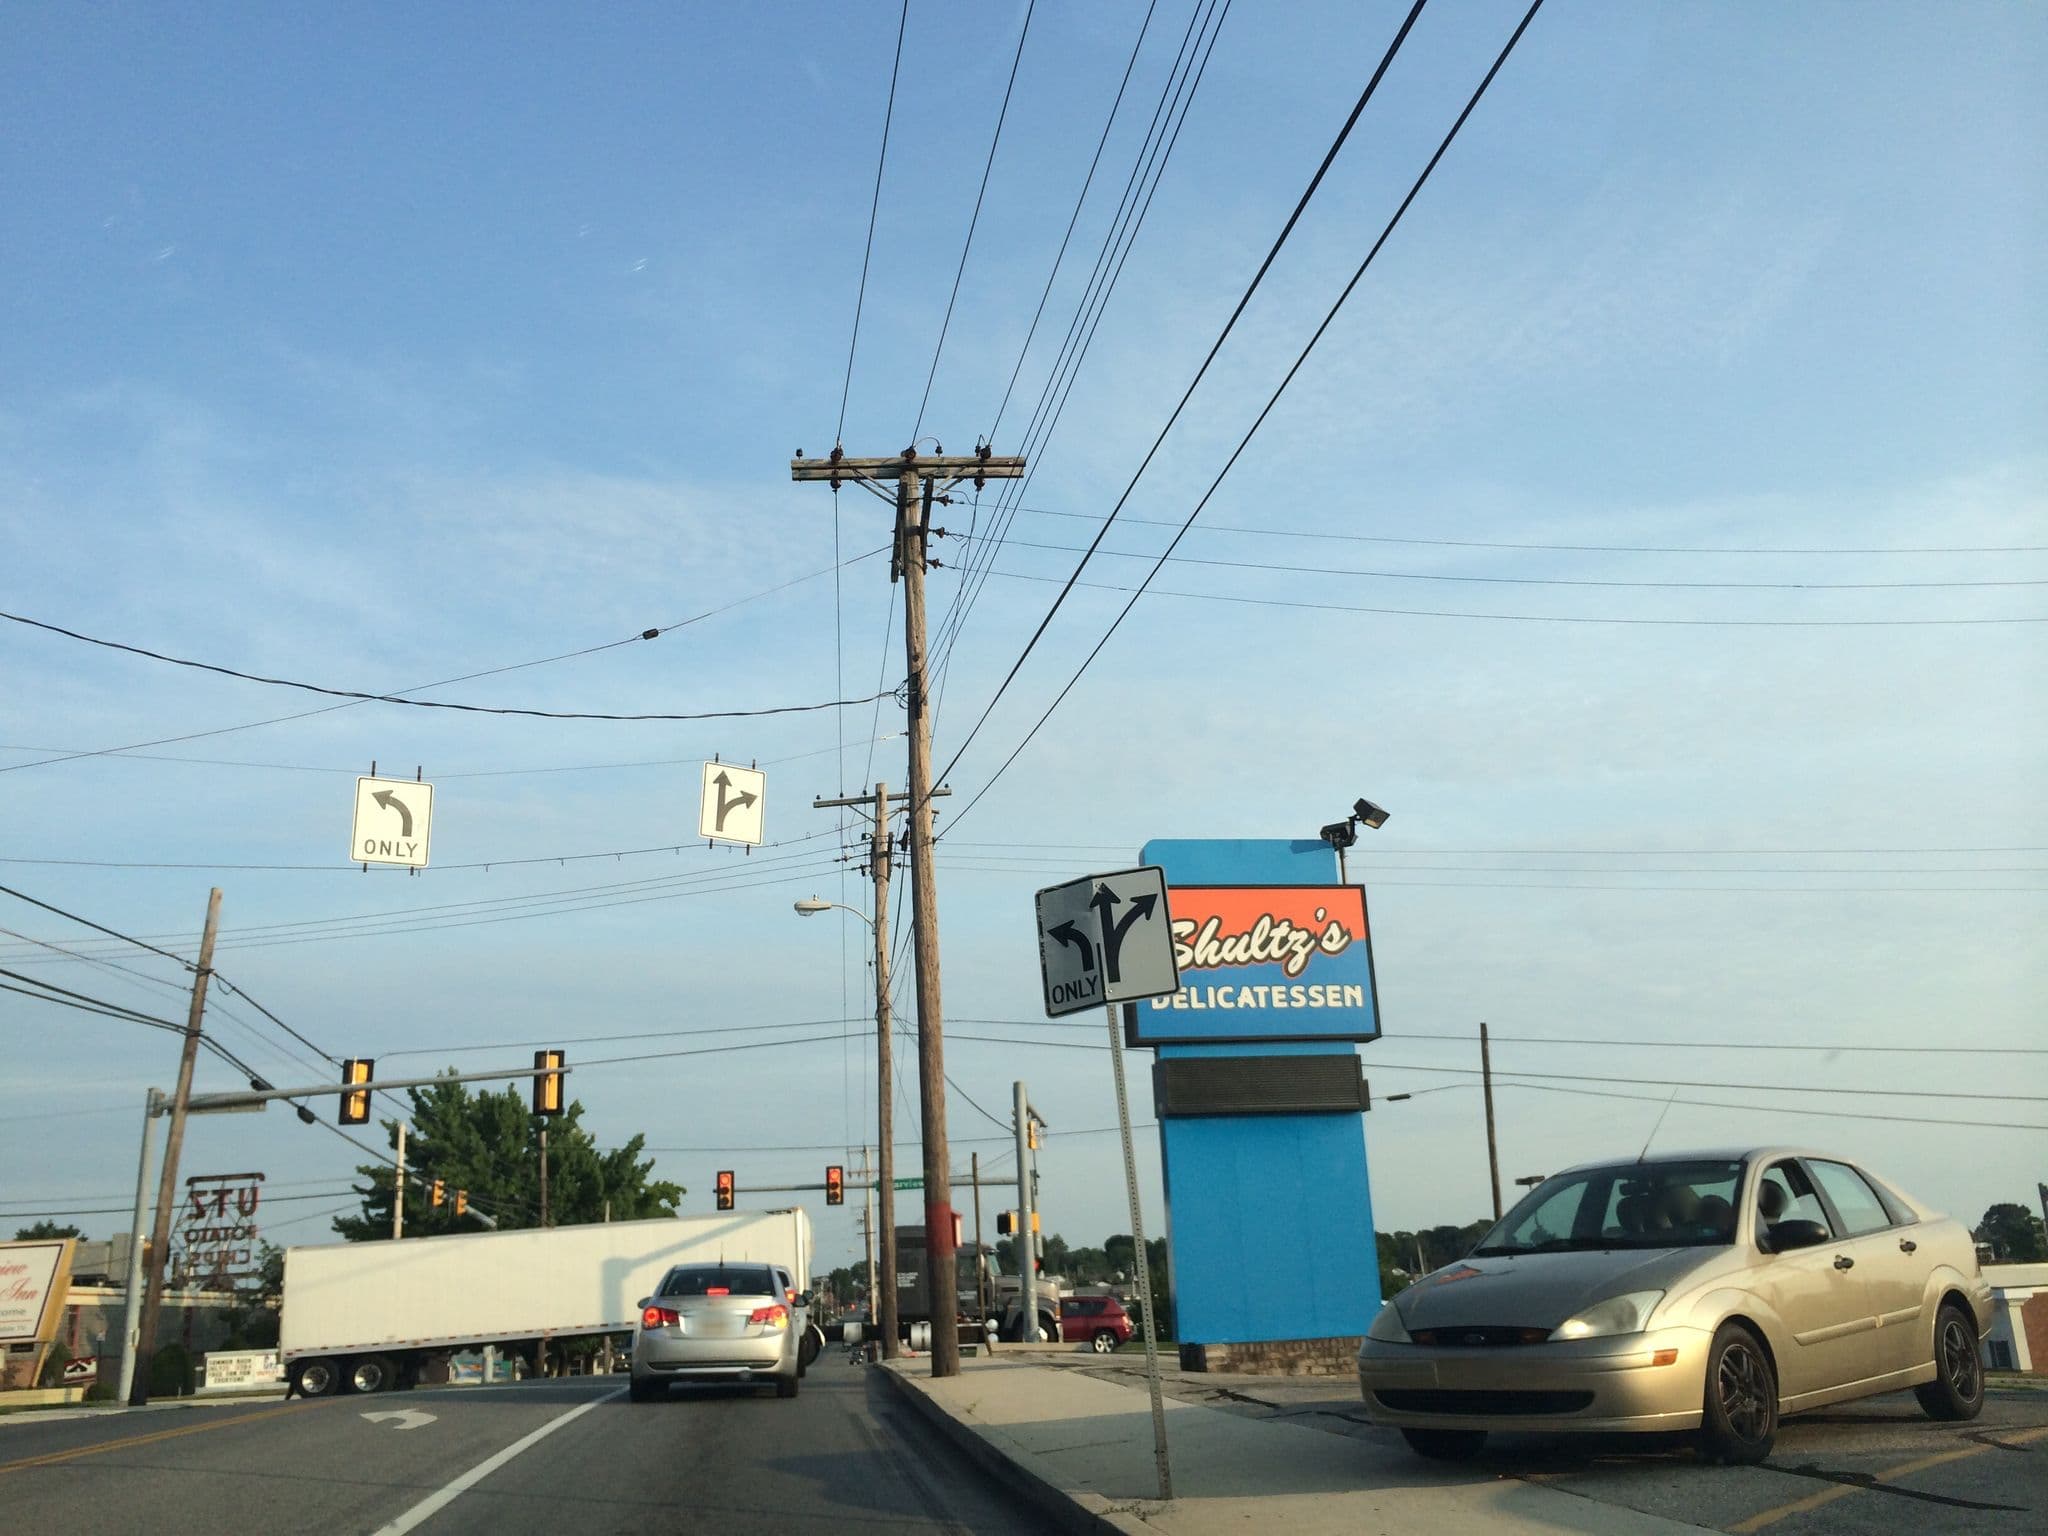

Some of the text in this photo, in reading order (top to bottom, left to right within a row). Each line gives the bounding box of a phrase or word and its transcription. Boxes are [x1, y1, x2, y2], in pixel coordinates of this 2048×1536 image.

[364, 840, 418, 856] ONLY
[1172, 906, 1351, 977] Shultz's
[1052, 974, 1098, 1004] ONLY
[1151, 985, 1364, 1010] DELICATESSEN
